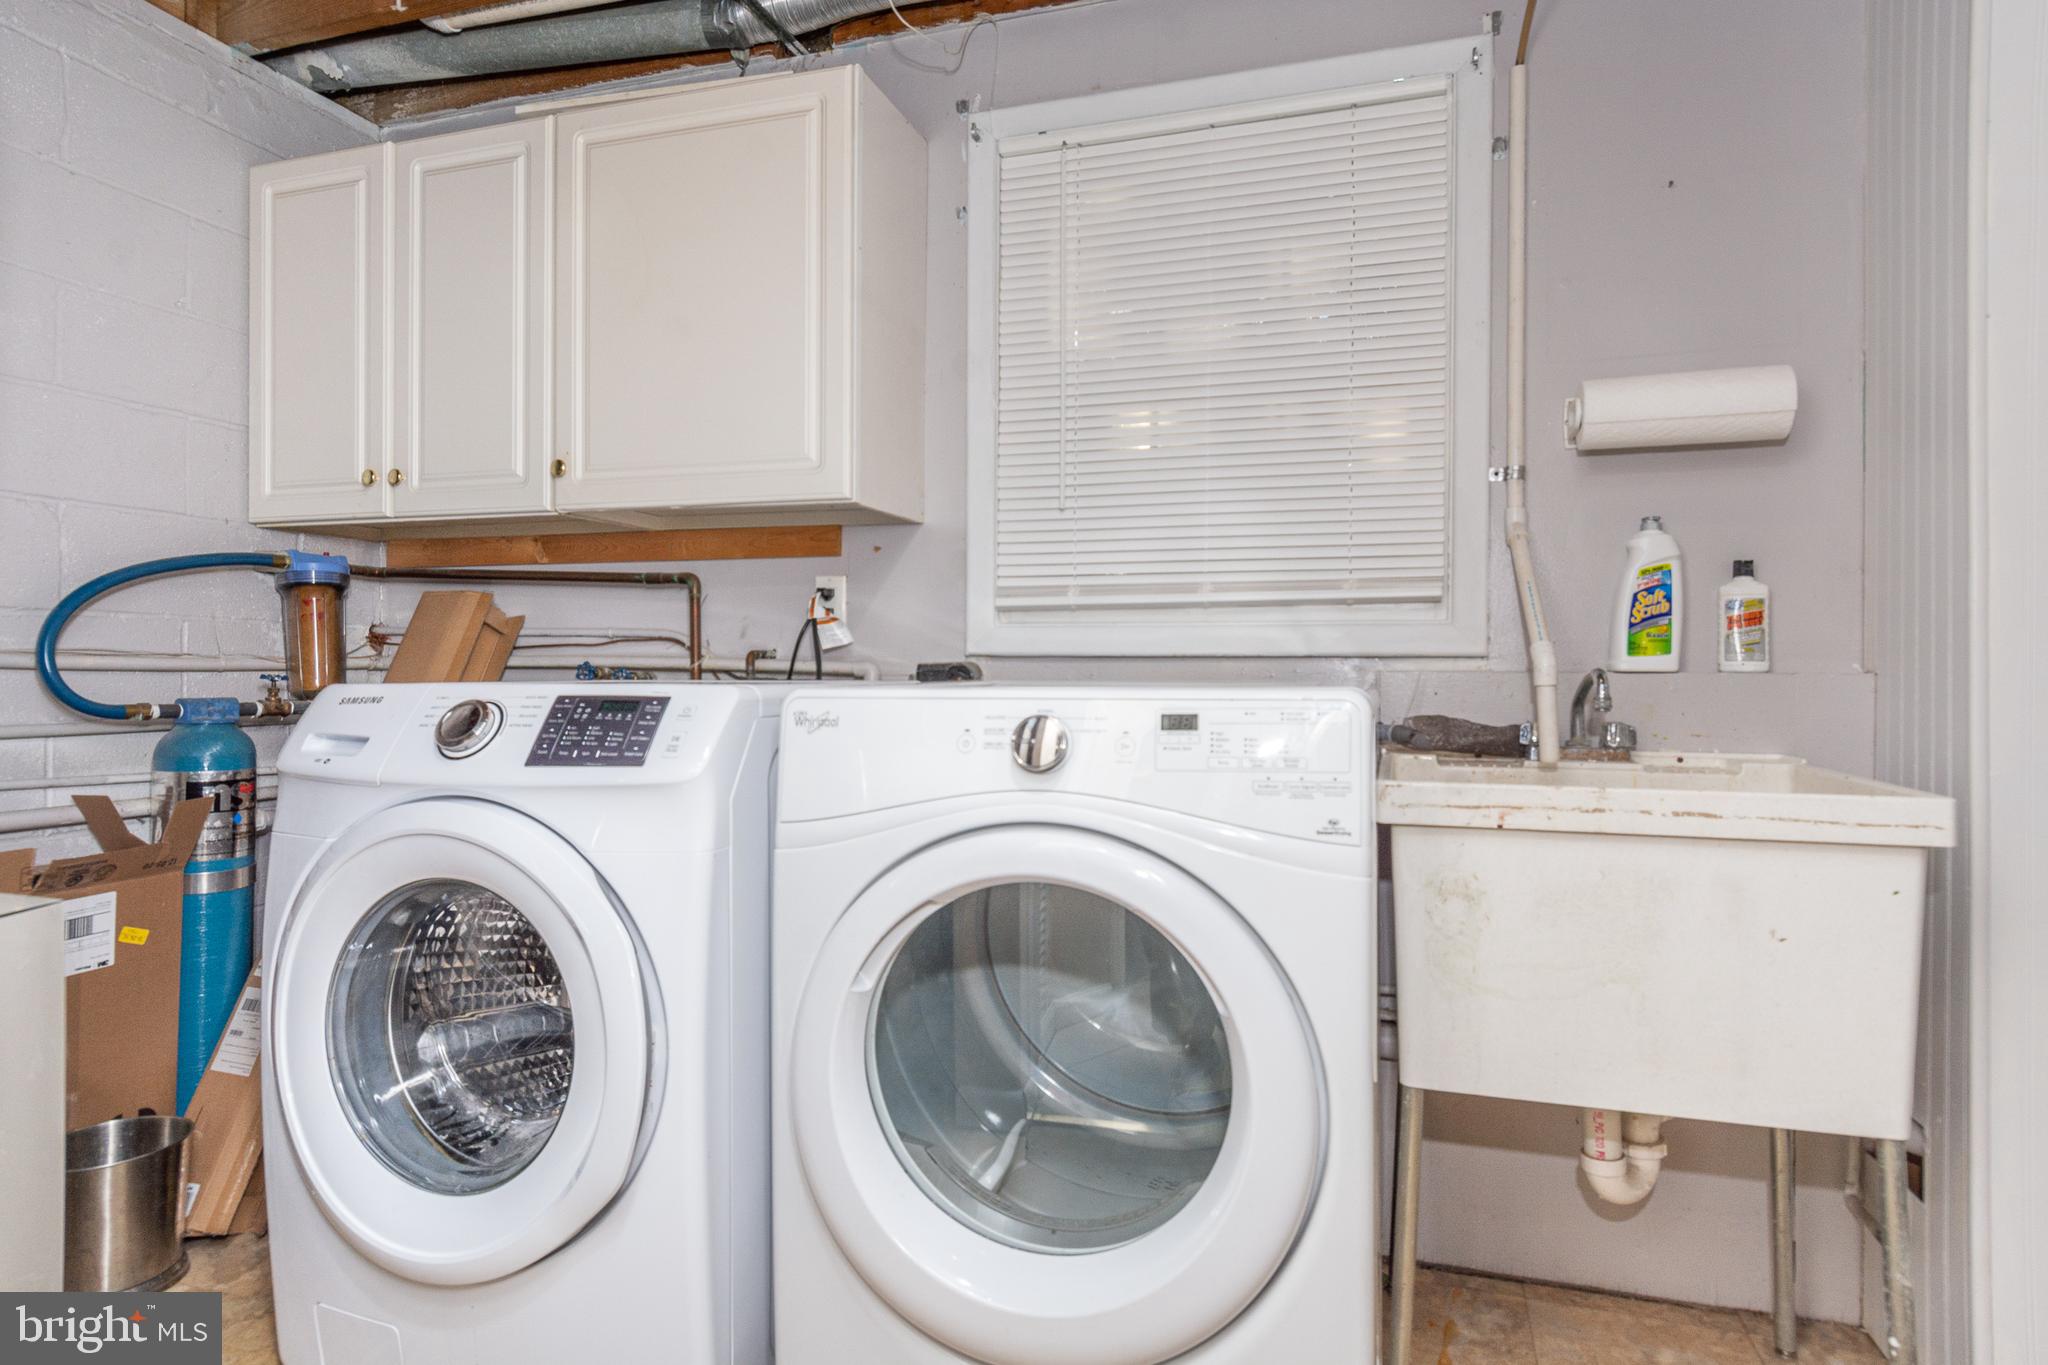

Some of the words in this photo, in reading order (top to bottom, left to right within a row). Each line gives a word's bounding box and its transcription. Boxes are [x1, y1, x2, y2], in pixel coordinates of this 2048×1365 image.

[1636, 590, 1667, 607] Soft
[1631, 599, 1671, 623] Scrub
[339, 696, 384, 705] SAMSUNG
[793, 713, 840, 733] Whirlpool
